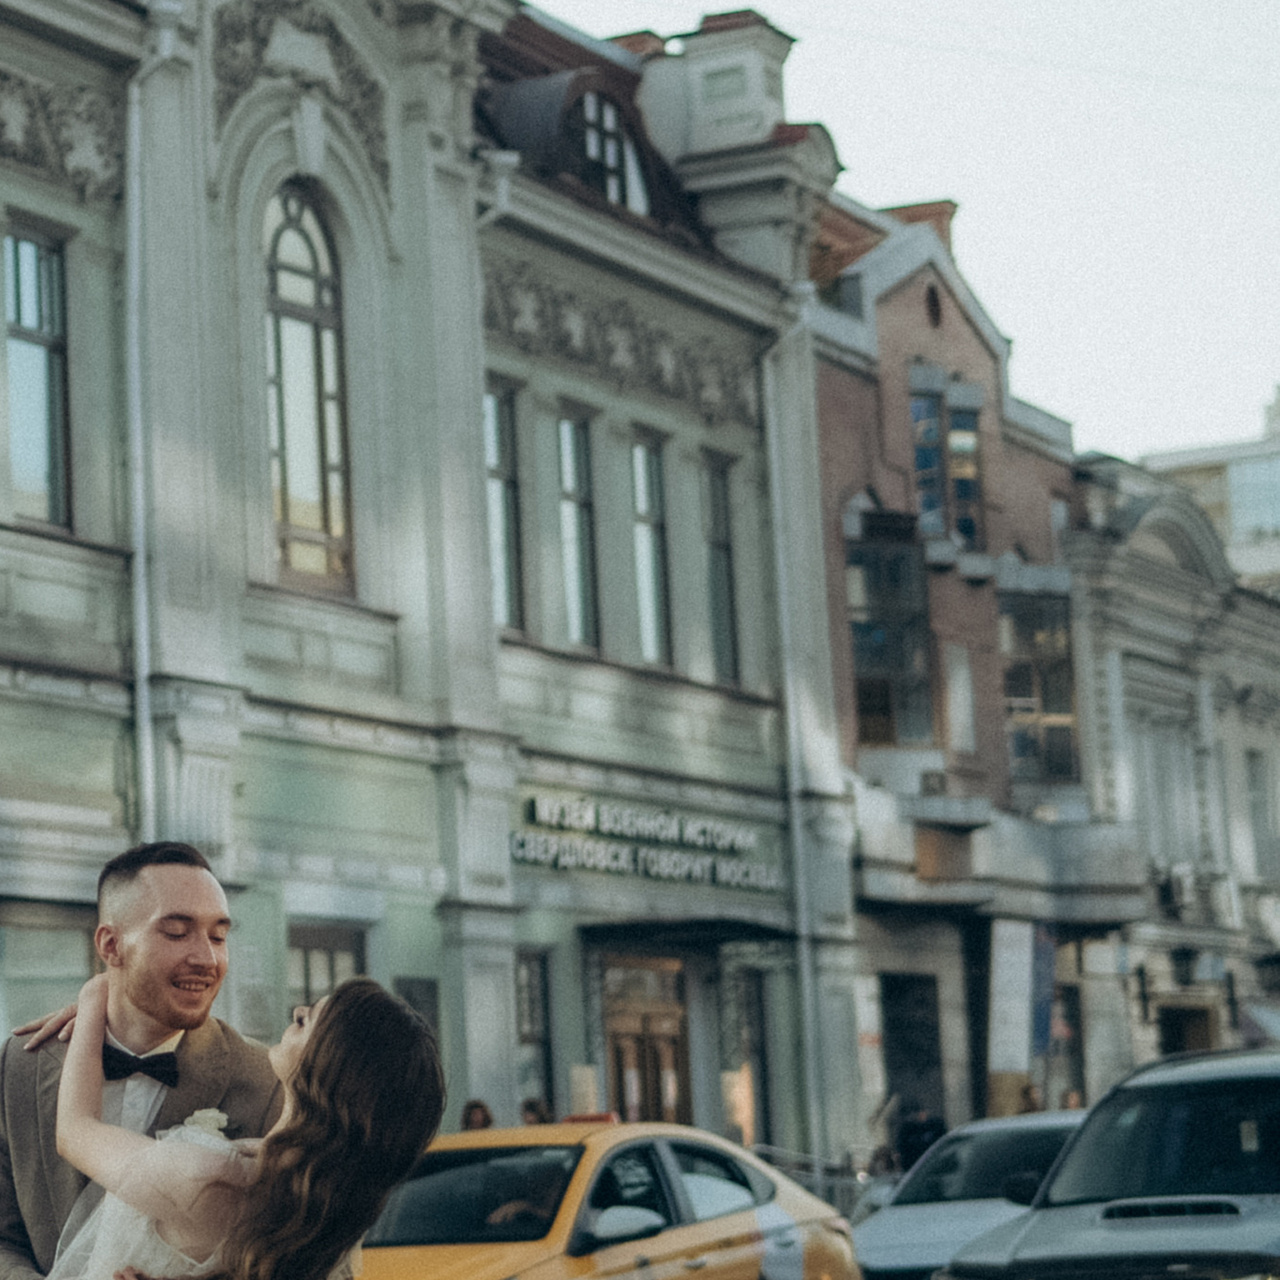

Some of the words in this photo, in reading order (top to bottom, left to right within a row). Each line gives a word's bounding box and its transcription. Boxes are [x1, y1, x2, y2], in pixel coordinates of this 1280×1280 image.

[533, 795, 596, 827] МУЗЕЙ
[598, 804, 680, 843] ВОЕННОЙ
[682, 817, 758, 852] ИСТОРИИ
[512, 831, 634, 873] СВЕРДЛОВСК
[637, 846, 714, 883] ГОВОРИТ
[716, 858, 781, 892] МОСКВА
